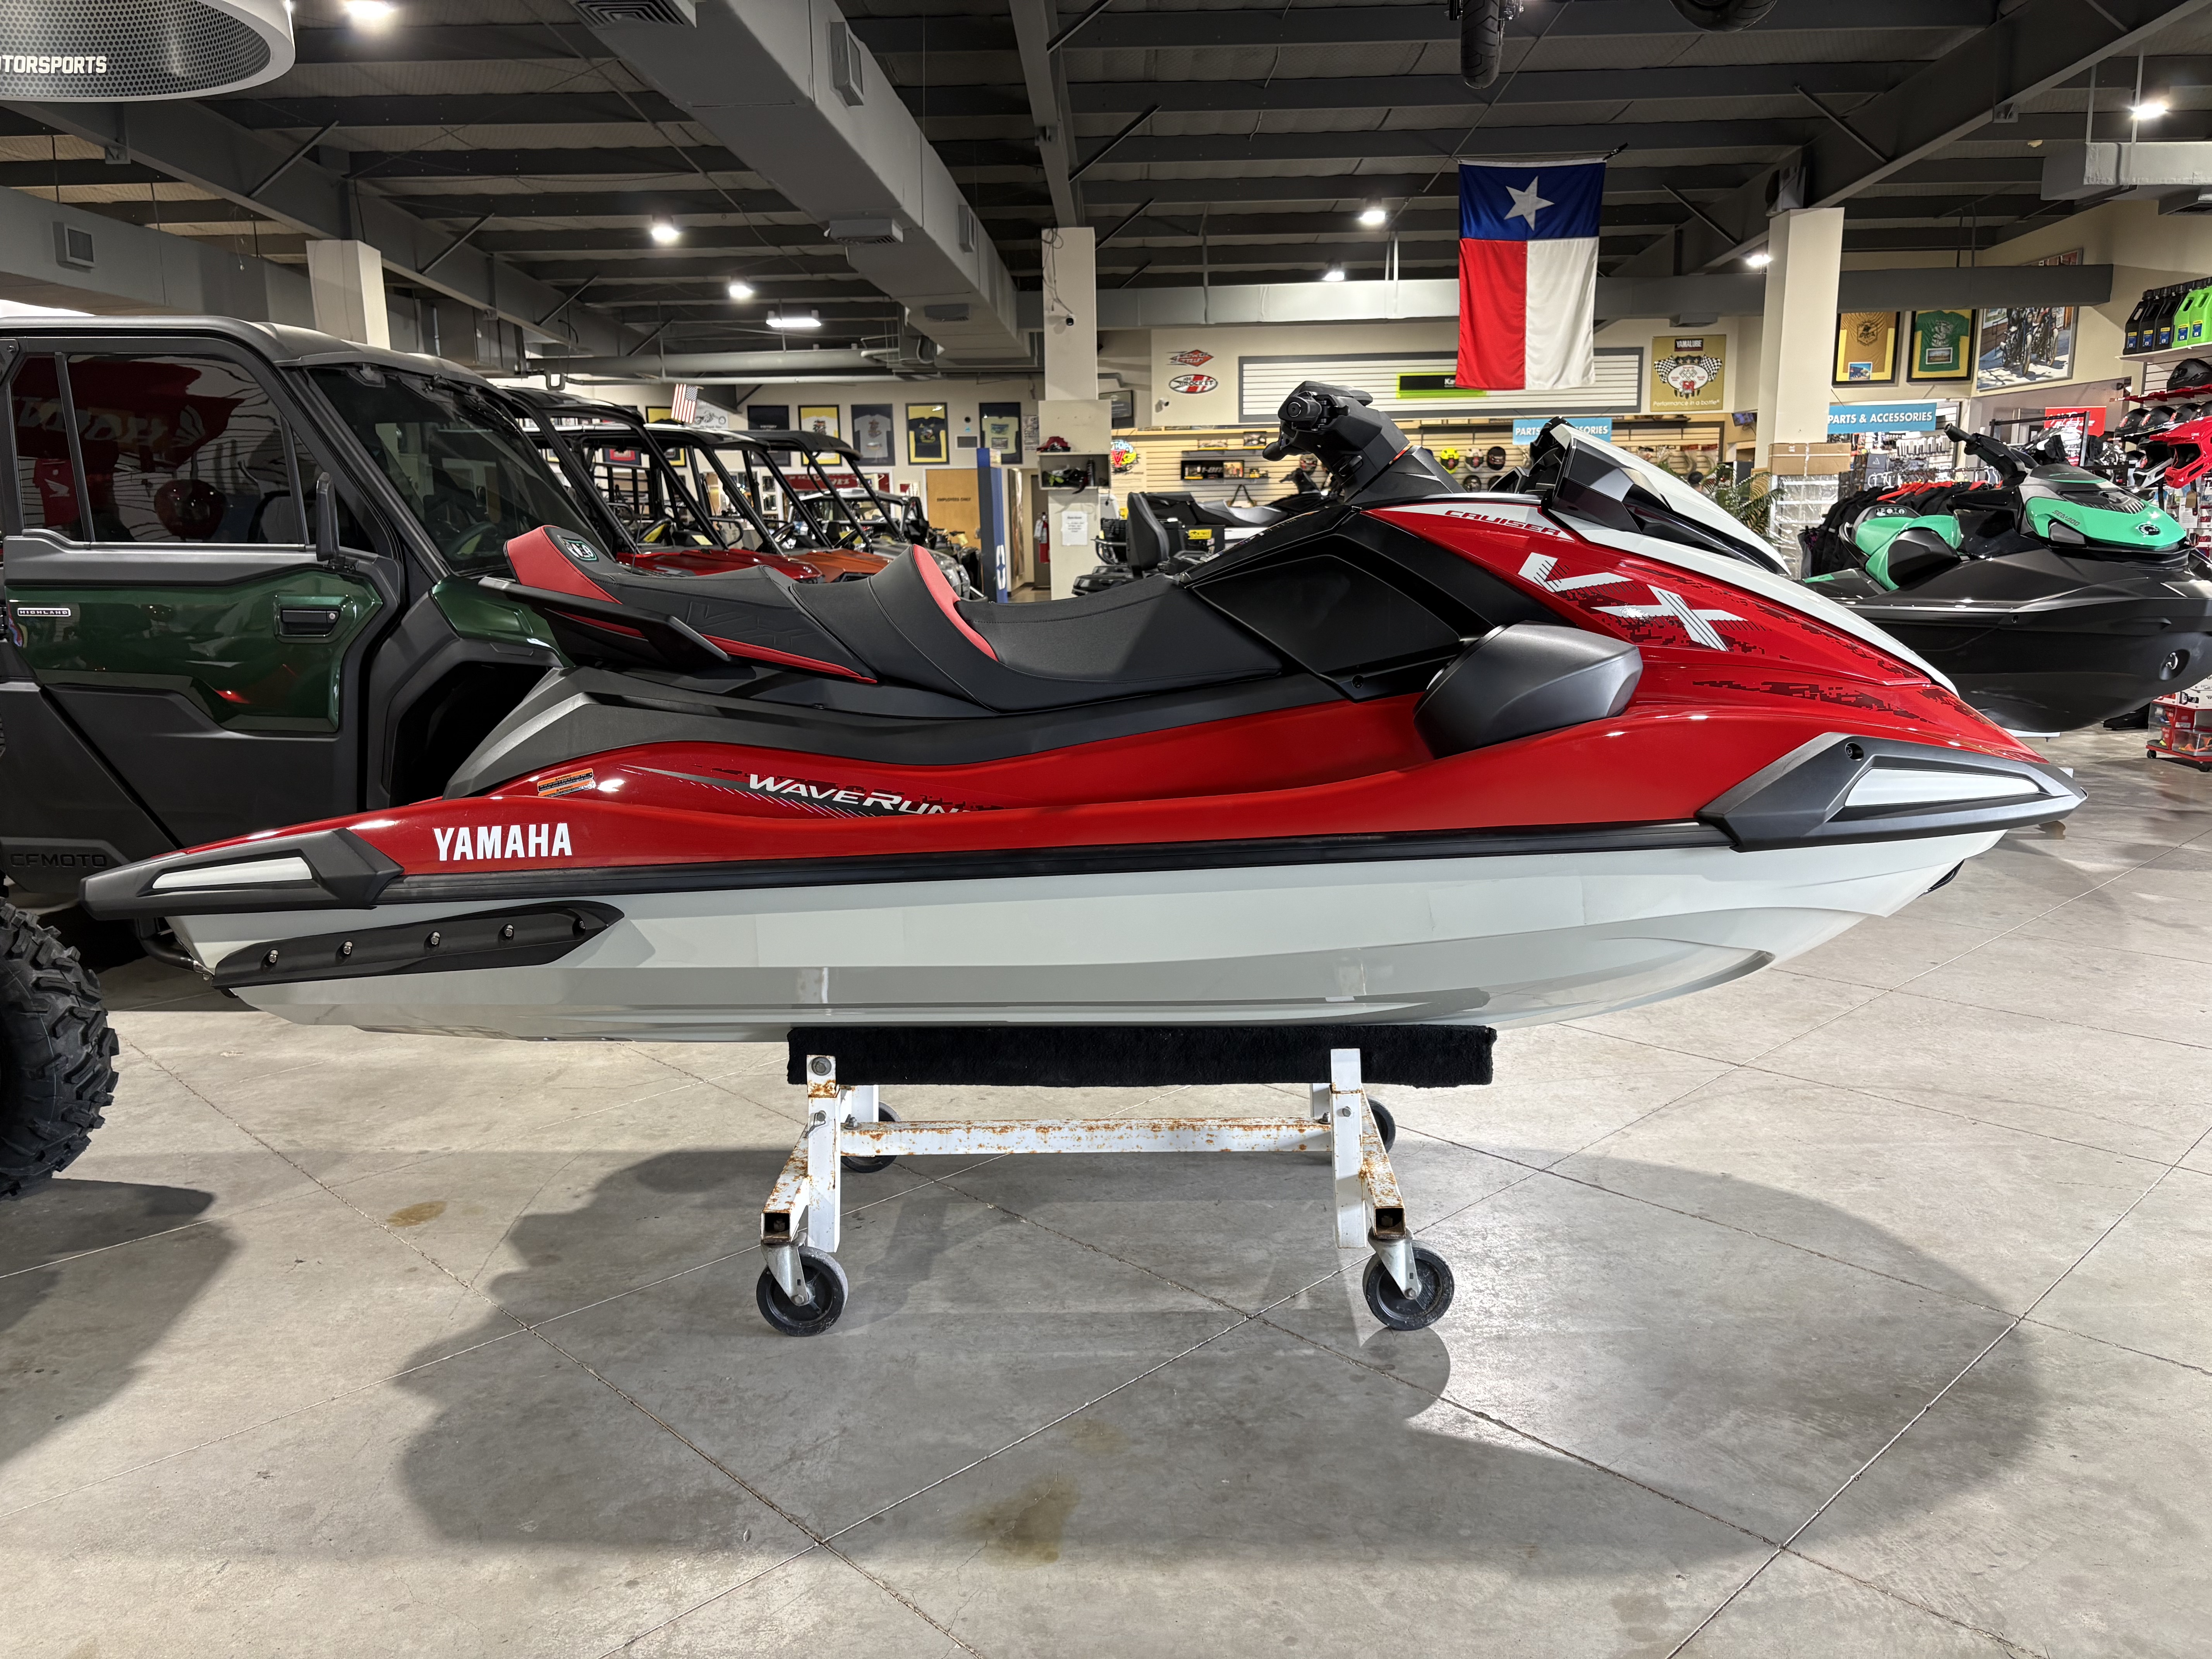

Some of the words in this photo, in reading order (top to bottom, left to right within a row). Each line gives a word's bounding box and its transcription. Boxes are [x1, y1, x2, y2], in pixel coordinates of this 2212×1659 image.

[0, 55, 107, 74] TORSPORTS
[1676, 340, 1702, 348] YAMALUBE
[1827, 414, 1857, 424] PARTS
[1858, 414, 1867, 423] &
[1869, 411, 1933, 423] ACCESSORIES
[1515, 427, 1541, 436] PARTS
[1575, 425, 1608, 434] SORIES
[1444, 510, 1561, 536] CRUISER
[1518, 552, 1749, 651] VX
[749, 774, 971, 814] WAVERUN
[433, 823, 572, 861] YAMAHA
[10, 854, 107, 867] CFMOTO
